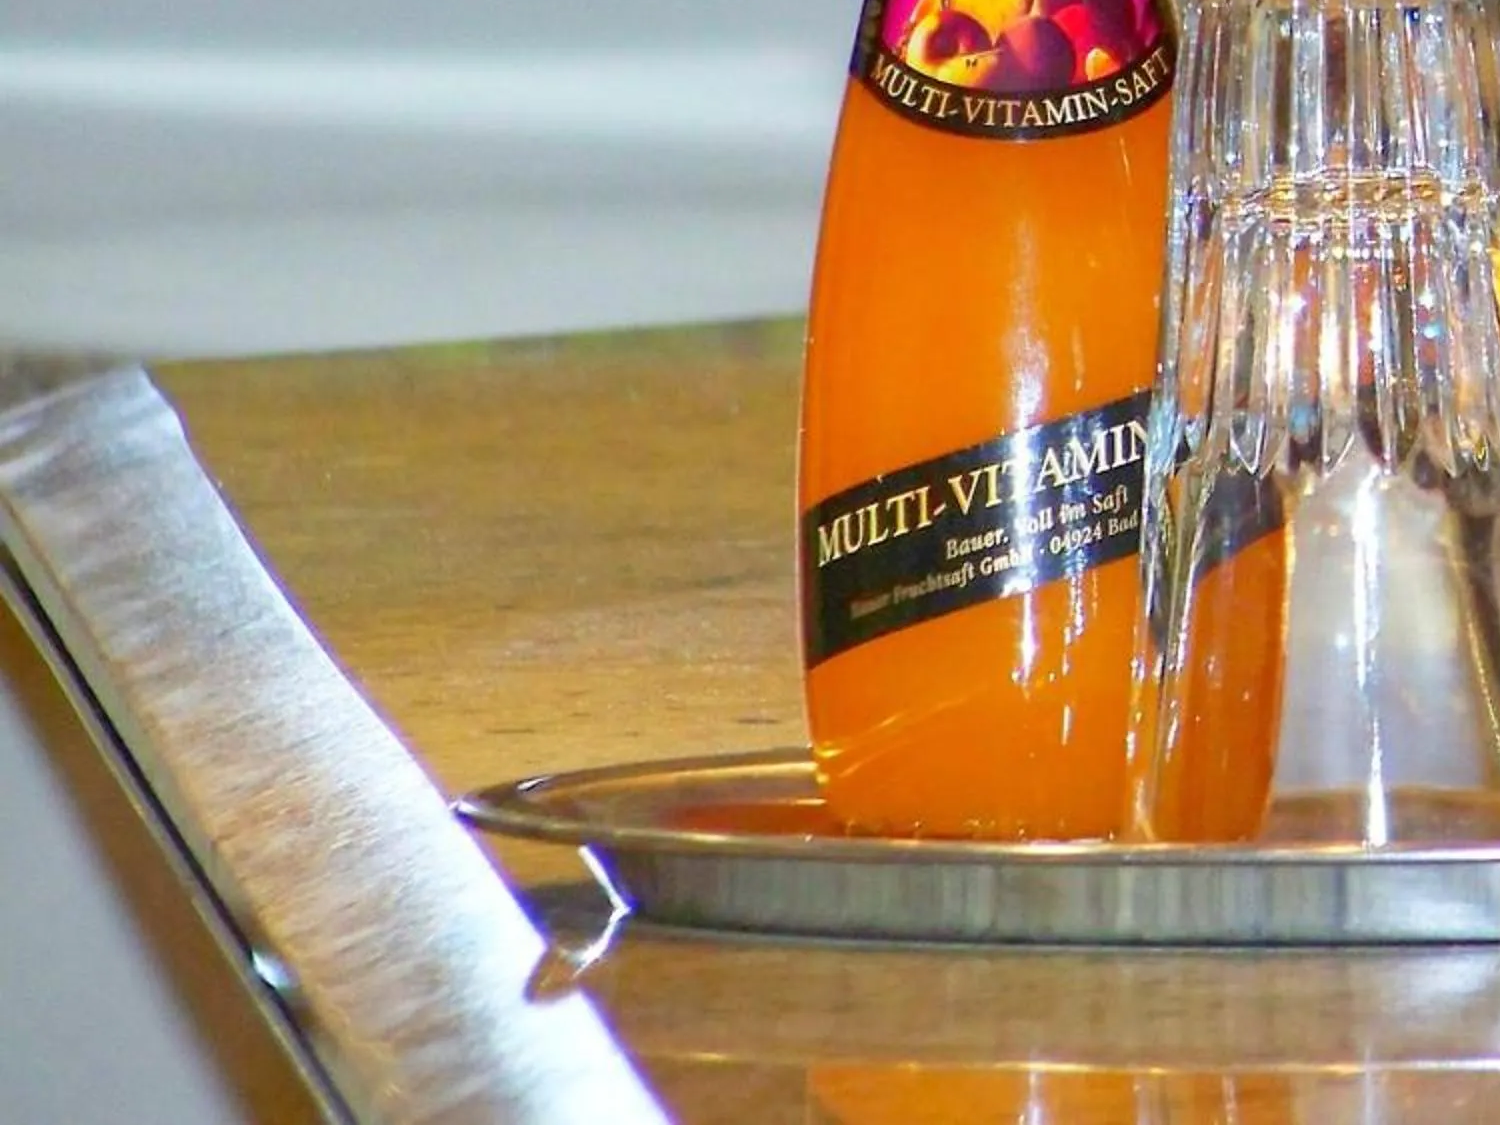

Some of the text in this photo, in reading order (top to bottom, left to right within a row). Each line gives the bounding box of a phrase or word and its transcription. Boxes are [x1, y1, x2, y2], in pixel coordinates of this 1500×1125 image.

[871, 52, 1171, 127] MULTI-VITAMIN-SAFT
[946, 527, 1009, 560] Bauer.
[1092, 483, 1129, 514] Saft
[1050, 520, 1103, 556] 04924
[1107, 509, 1139, 536] Bad
